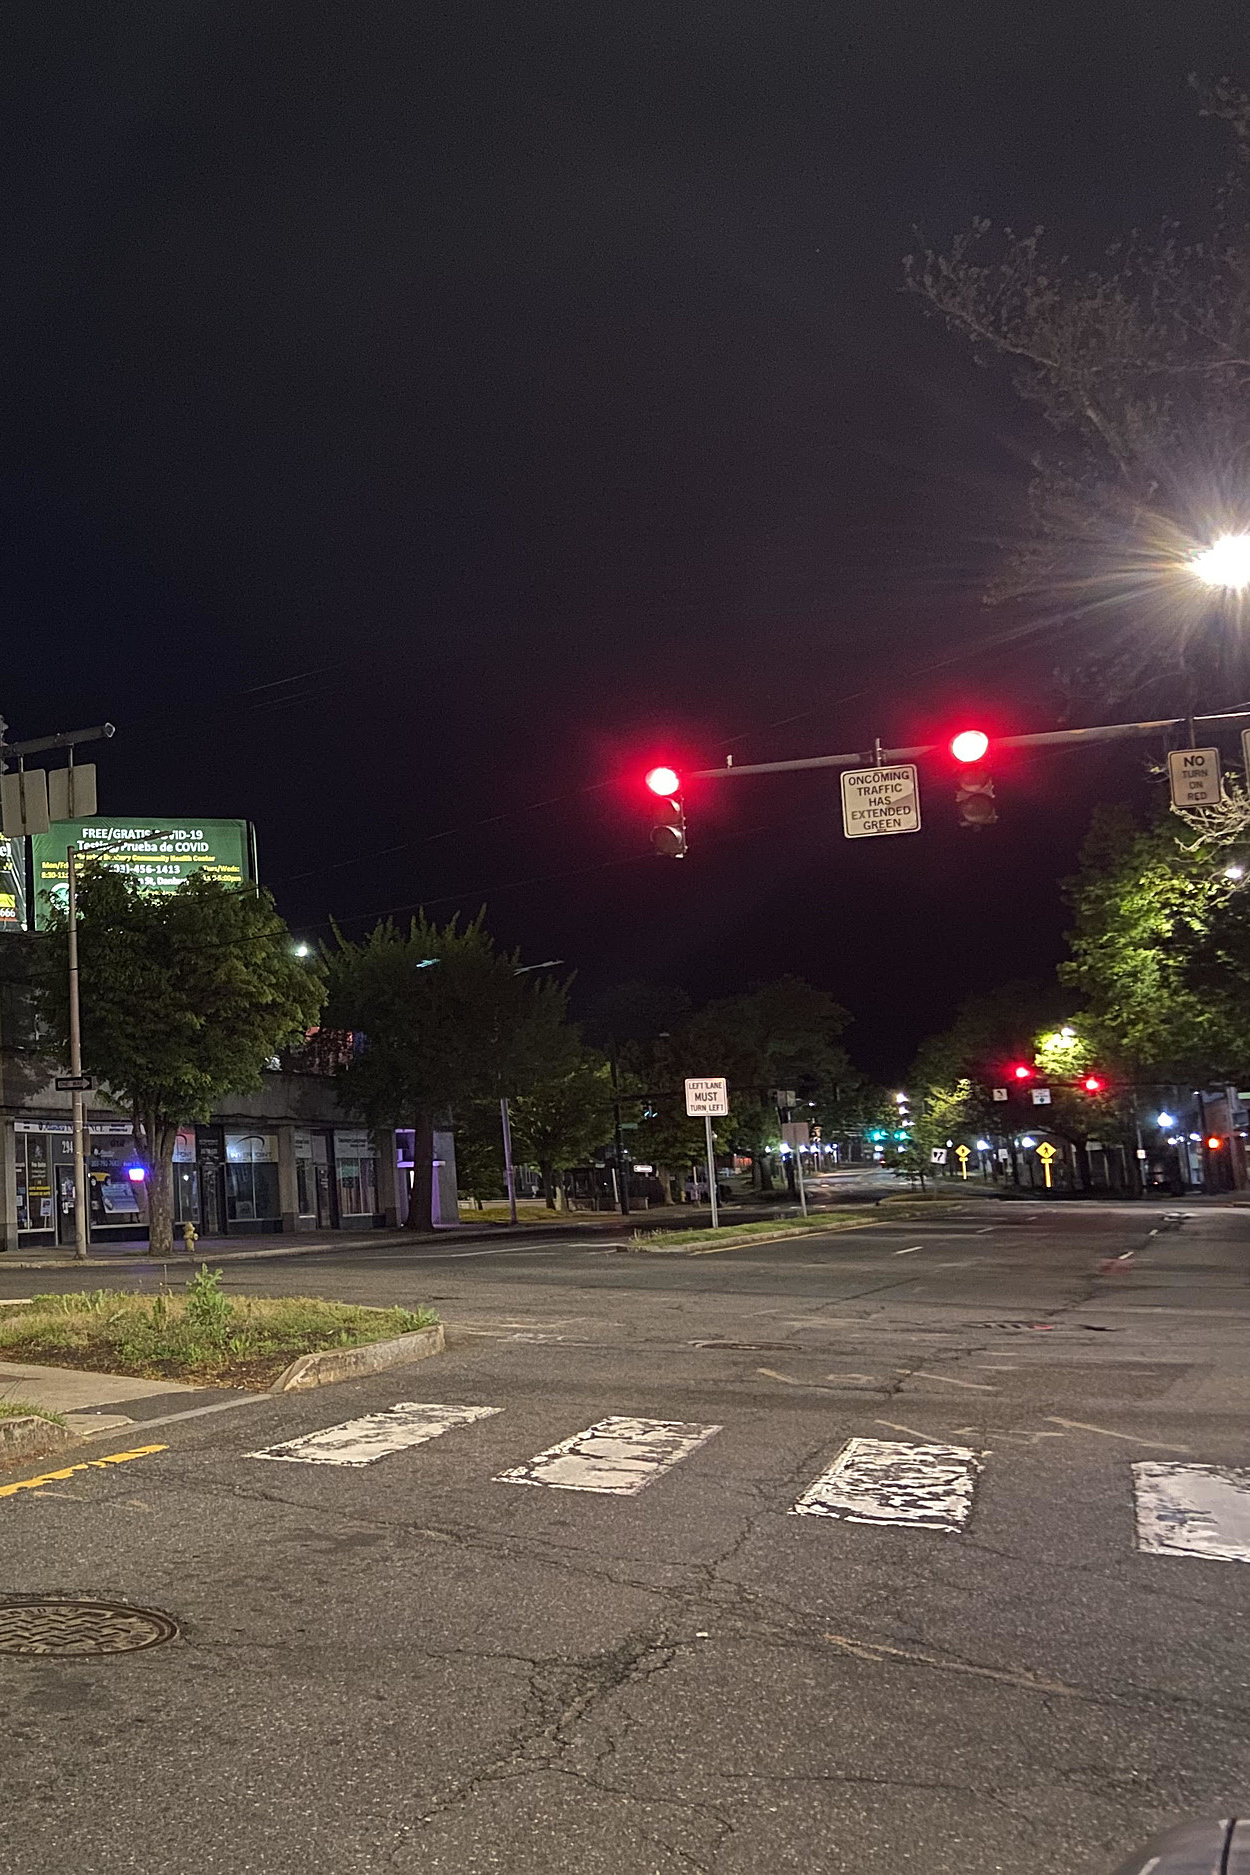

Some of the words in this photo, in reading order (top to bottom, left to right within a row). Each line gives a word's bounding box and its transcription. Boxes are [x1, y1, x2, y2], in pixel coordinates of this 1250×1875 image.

[1183, 755, 1205, 768] NO
[848, 770, 910, 786] ONCOMING
[1181, 769, 1208, 778] TURN
[857, 783, 903, 797] TRAFFIC
[1189, 781, 1204, 790] ON
[868, 796, 892, 807] HAS
[1187, 791, 1207, 801] RED
[851, 805, 911, 820] EXTENDED
[863, 818, 902, 830] GREEN
[82, 828, 151, 840] FREE/GRATIS
[159, 841, 173, 852] de
[175, 842, 209, 852] COVID
[689, 1082, 703, 1090] LEFT
[706, 1082, 722, 1090] LANE
[695, 1092, 717, 1101] MUST
[690, 1104, 707, 1112] TURN
